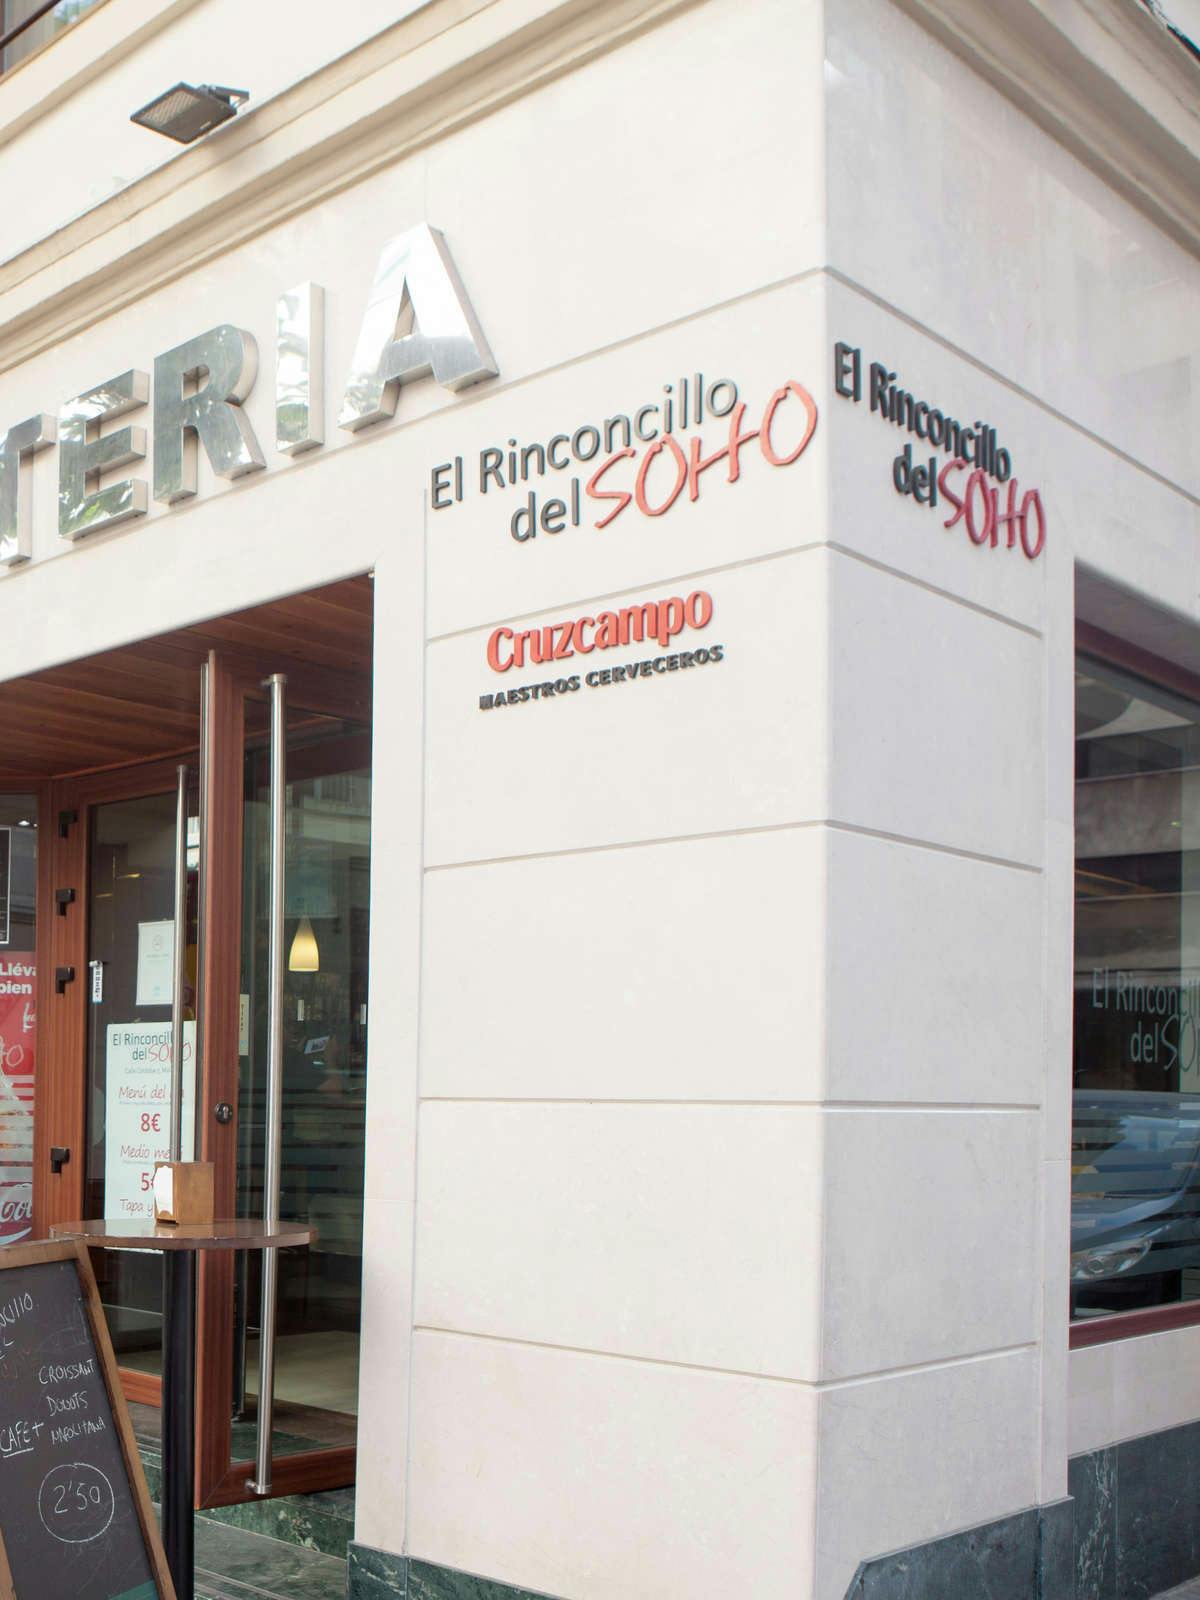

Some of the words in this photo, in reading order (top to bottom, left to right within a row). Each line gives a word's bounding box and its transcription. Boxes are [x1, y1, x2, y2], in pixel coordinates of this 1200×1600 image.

[430, 455, 464, 510] El
[479, 372, 739, 494] Rinconcillo
[834, 341, 862, 402] El
[870, 361, 1012, 483] Rinconcillo
[509, 477, 581, 543] del
[585, 379, 818, 529] SOHO
[893, 443, 937, 507] del
[937, 458, 1047, 560] SOHO
[486, 590, 714, 674] Cruzcampo
[478, 674, 581, 711] MAESTROS
[584, 644, 725, 689] CERVECEROS
[1093, 965, 1109, 1009] El
[124, 1031, 173, 1046] Rinconcill
[1130, 1021, 1159, 1063] del
[140, 1112, 161, 1132] 8€
